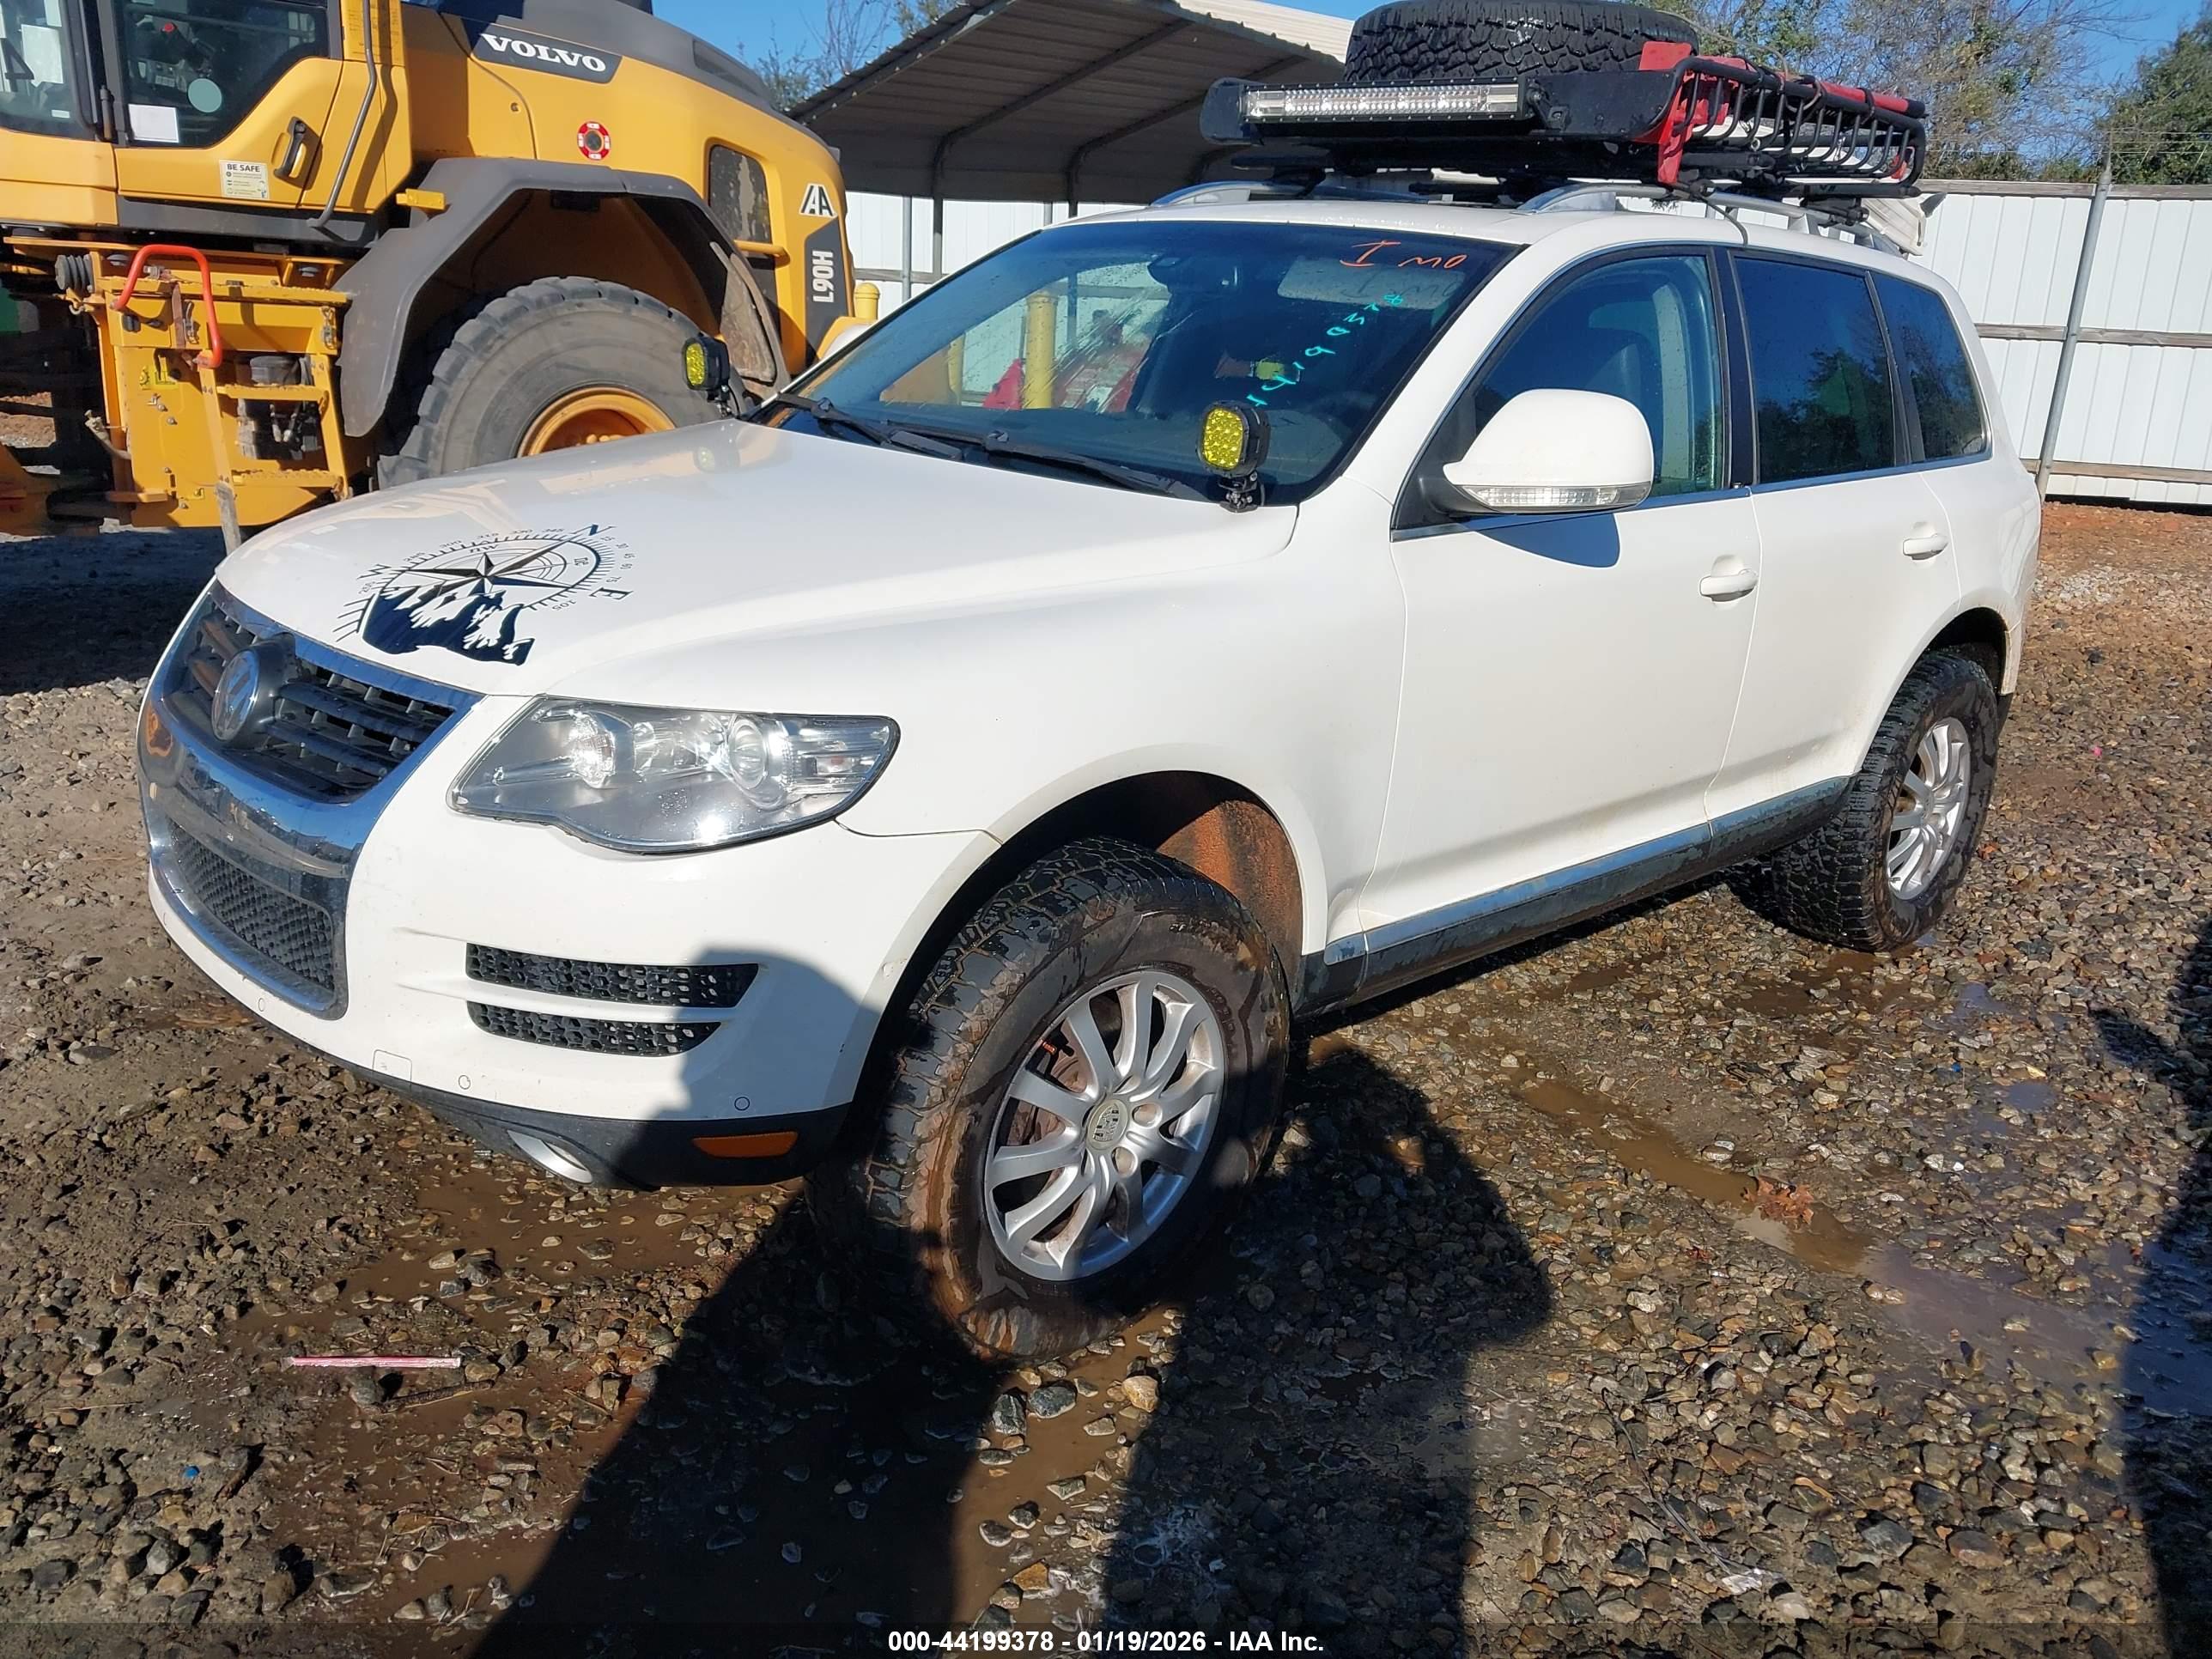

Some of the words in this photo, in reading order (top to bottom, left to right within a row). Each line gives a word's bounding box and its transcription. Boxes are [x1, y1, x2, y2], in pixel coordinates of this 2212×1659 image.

[481, 33, 606, 72] VOLVO
[240, 164, 261, 173] SAFE
[811, 250, 835, 303] L90H
[571, 524, 617, 537] N
[357, 563, 392, 580] W
[588, 586, 634, 600] E
[552, 599, 577, 611] 105
